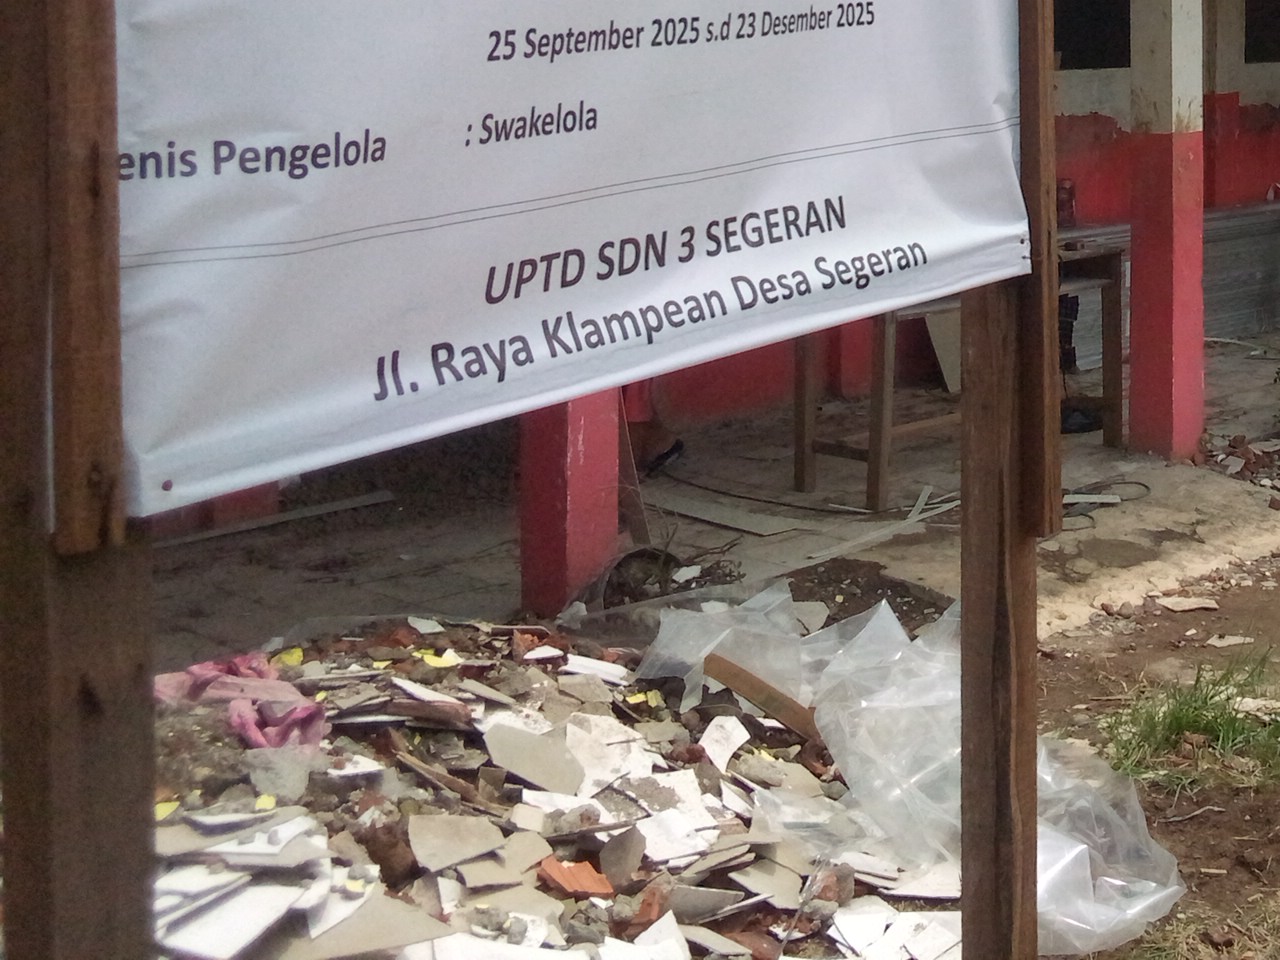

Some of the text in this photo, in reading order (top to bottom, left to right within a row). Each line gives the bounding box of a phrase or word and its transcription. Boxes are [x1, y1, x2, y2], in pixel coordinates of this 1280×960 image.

[486, 0, 876, 64] 25 September 2025 s.d 23 Desember 2025
[212, 127, 387, 181] Pengelola
[478, 99, 598, 146] Swakelola
[484, 194, 847, 306] UPTD SDN 3 SEGERAN
[373, 241, 930, 402] Jl. Raya Klampean Desa Segeran
